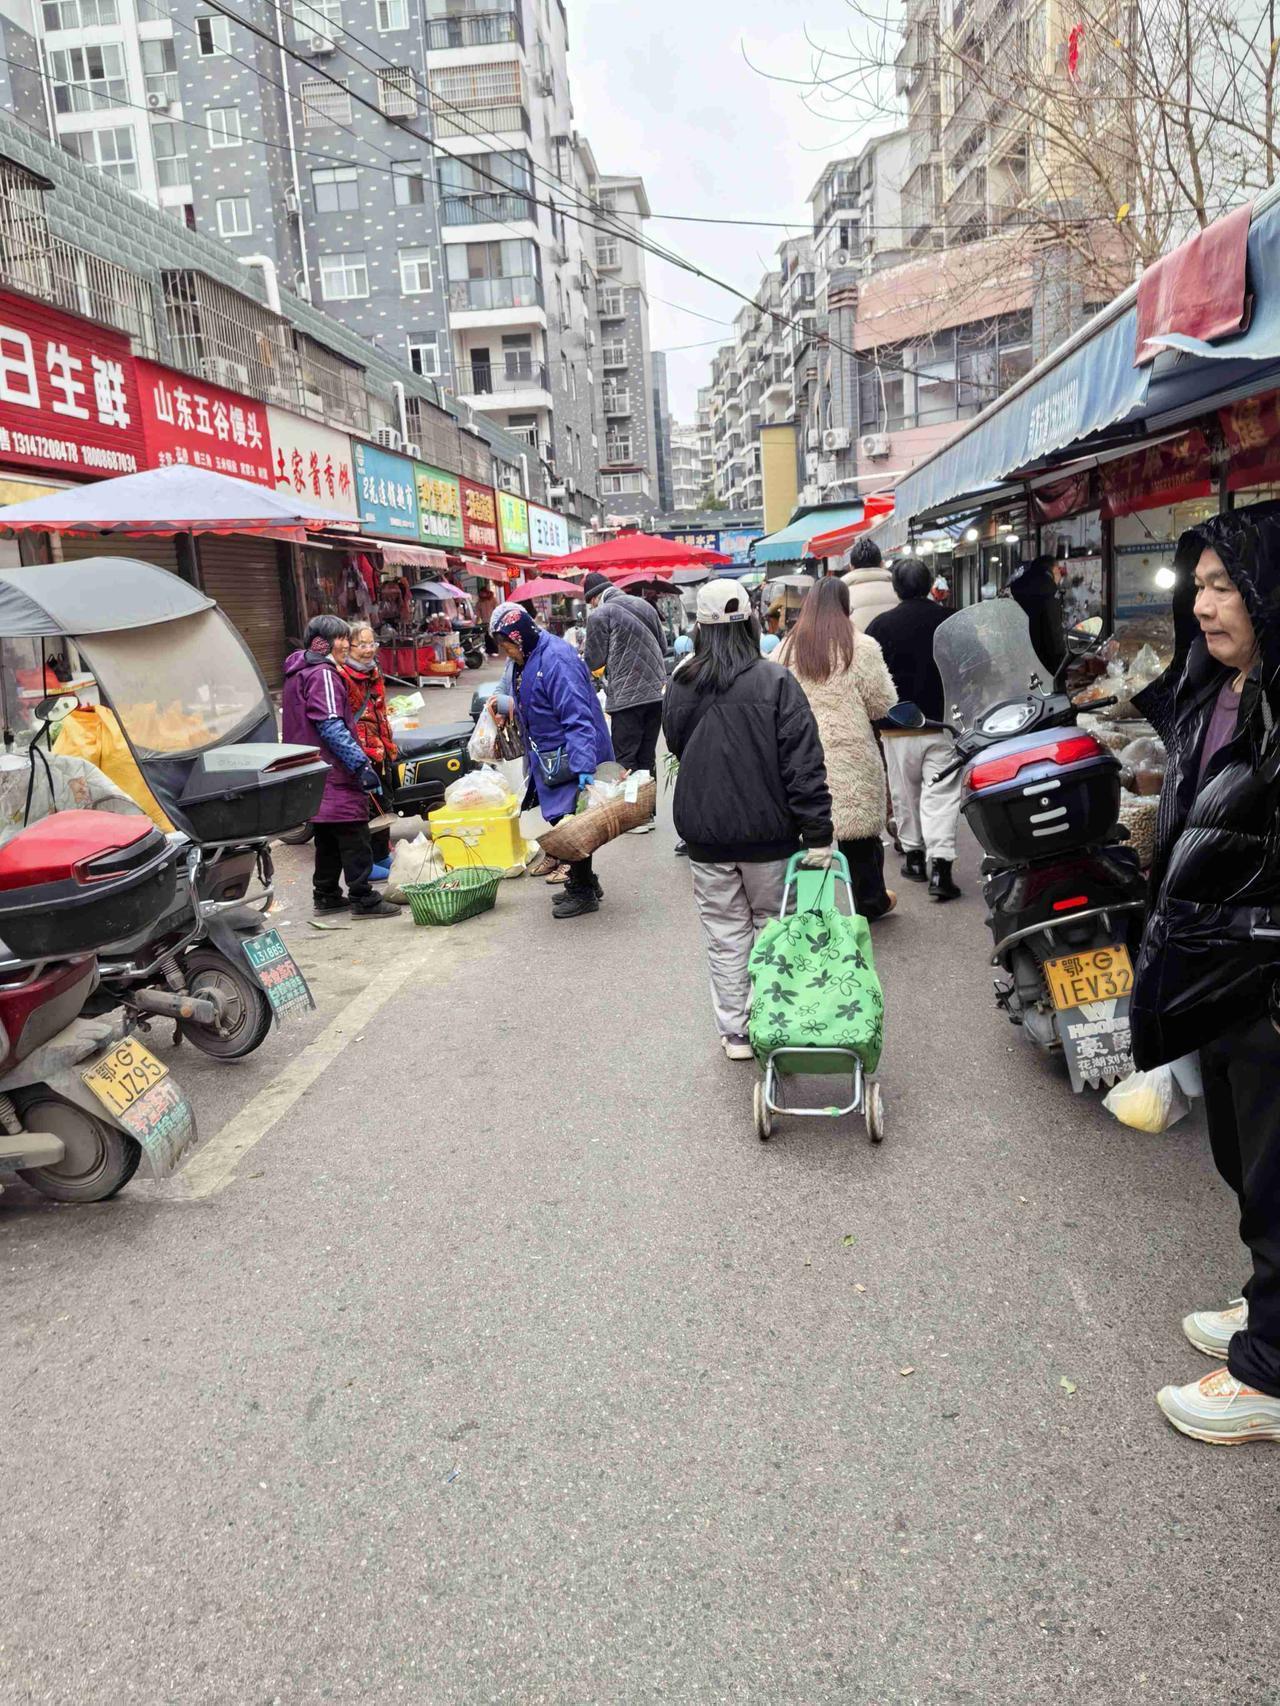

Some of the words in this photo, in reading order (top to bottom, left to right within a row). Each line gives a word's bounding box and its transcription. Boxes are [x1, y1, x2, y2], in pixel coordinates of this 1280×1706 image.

[153, 379, 263, 451] 山东五谷馒头
[253, 942, 285, 965] 131885
